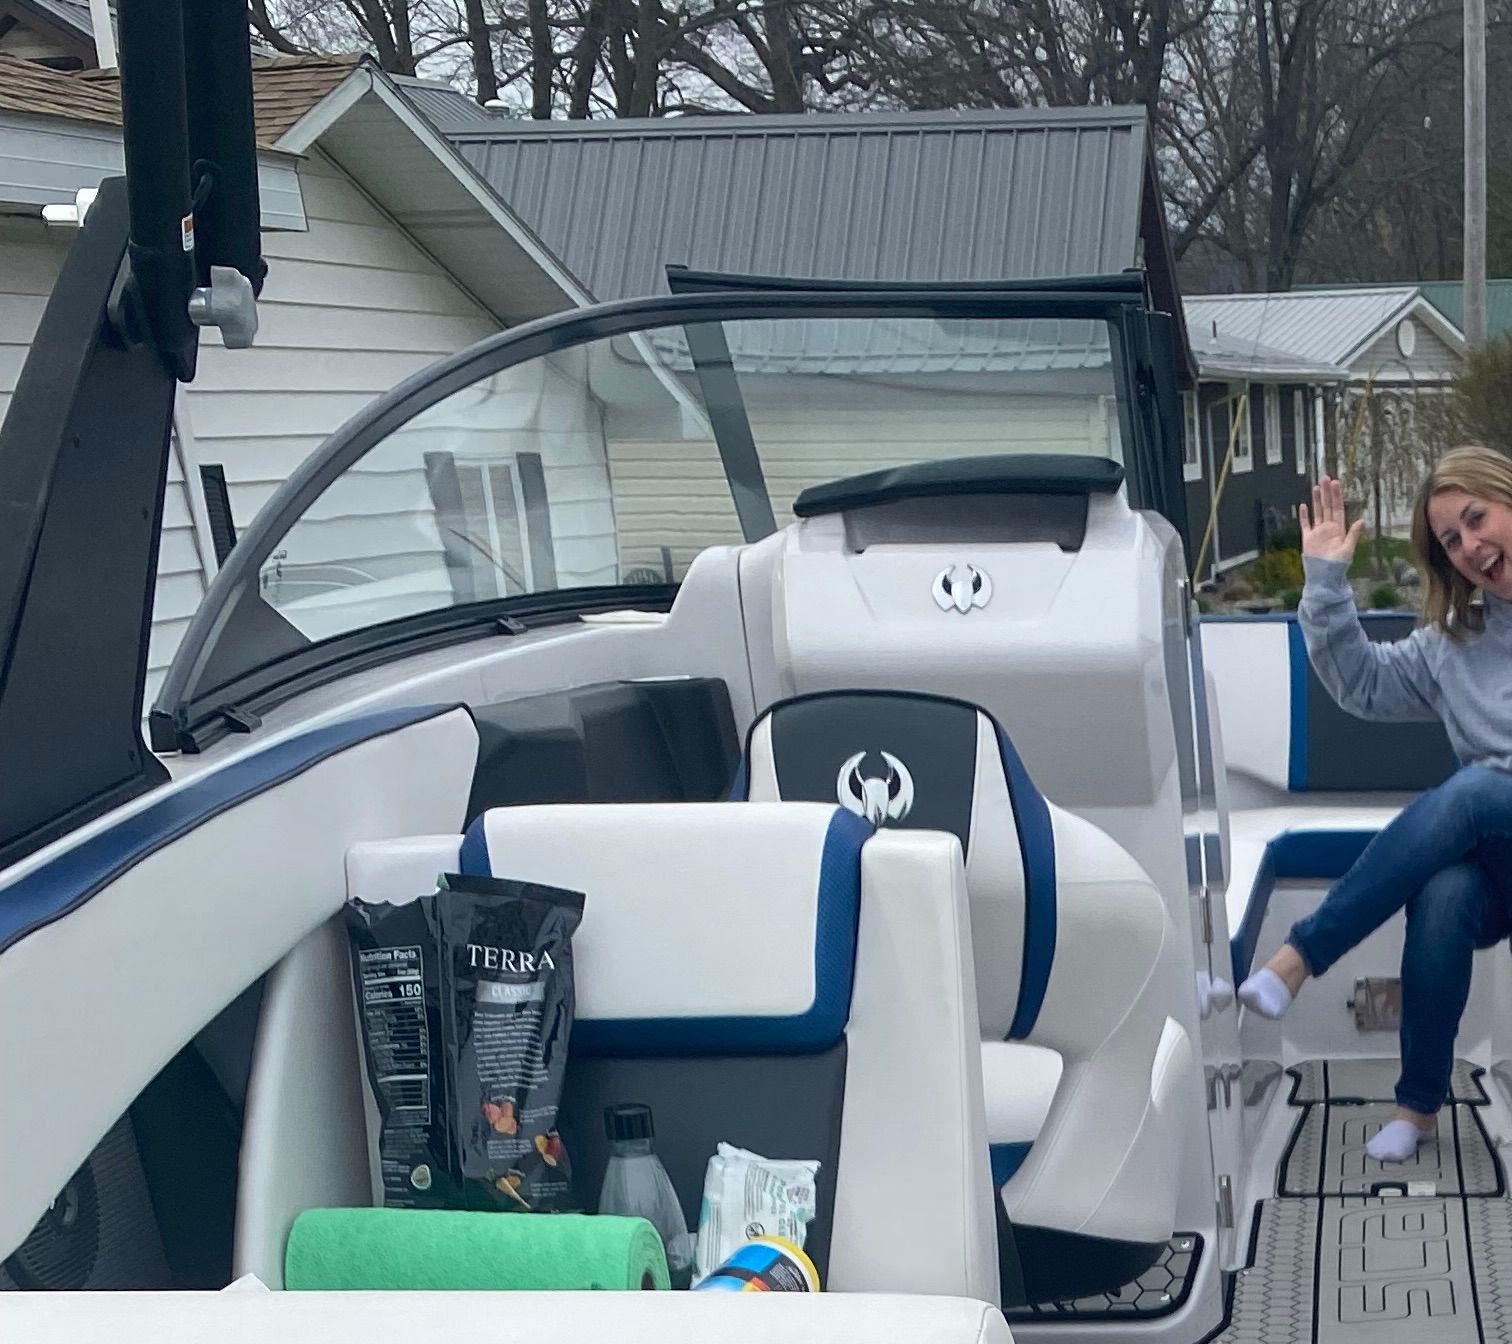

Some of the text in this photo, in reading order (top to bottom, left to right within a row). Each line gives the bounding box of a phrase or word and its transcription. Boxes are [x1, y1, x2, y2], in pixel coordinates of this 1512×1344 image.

[393, 949, 417, 960] Facts
[466, 944, 556, 973] TERRA
[398, 983, 422, 997] 150
